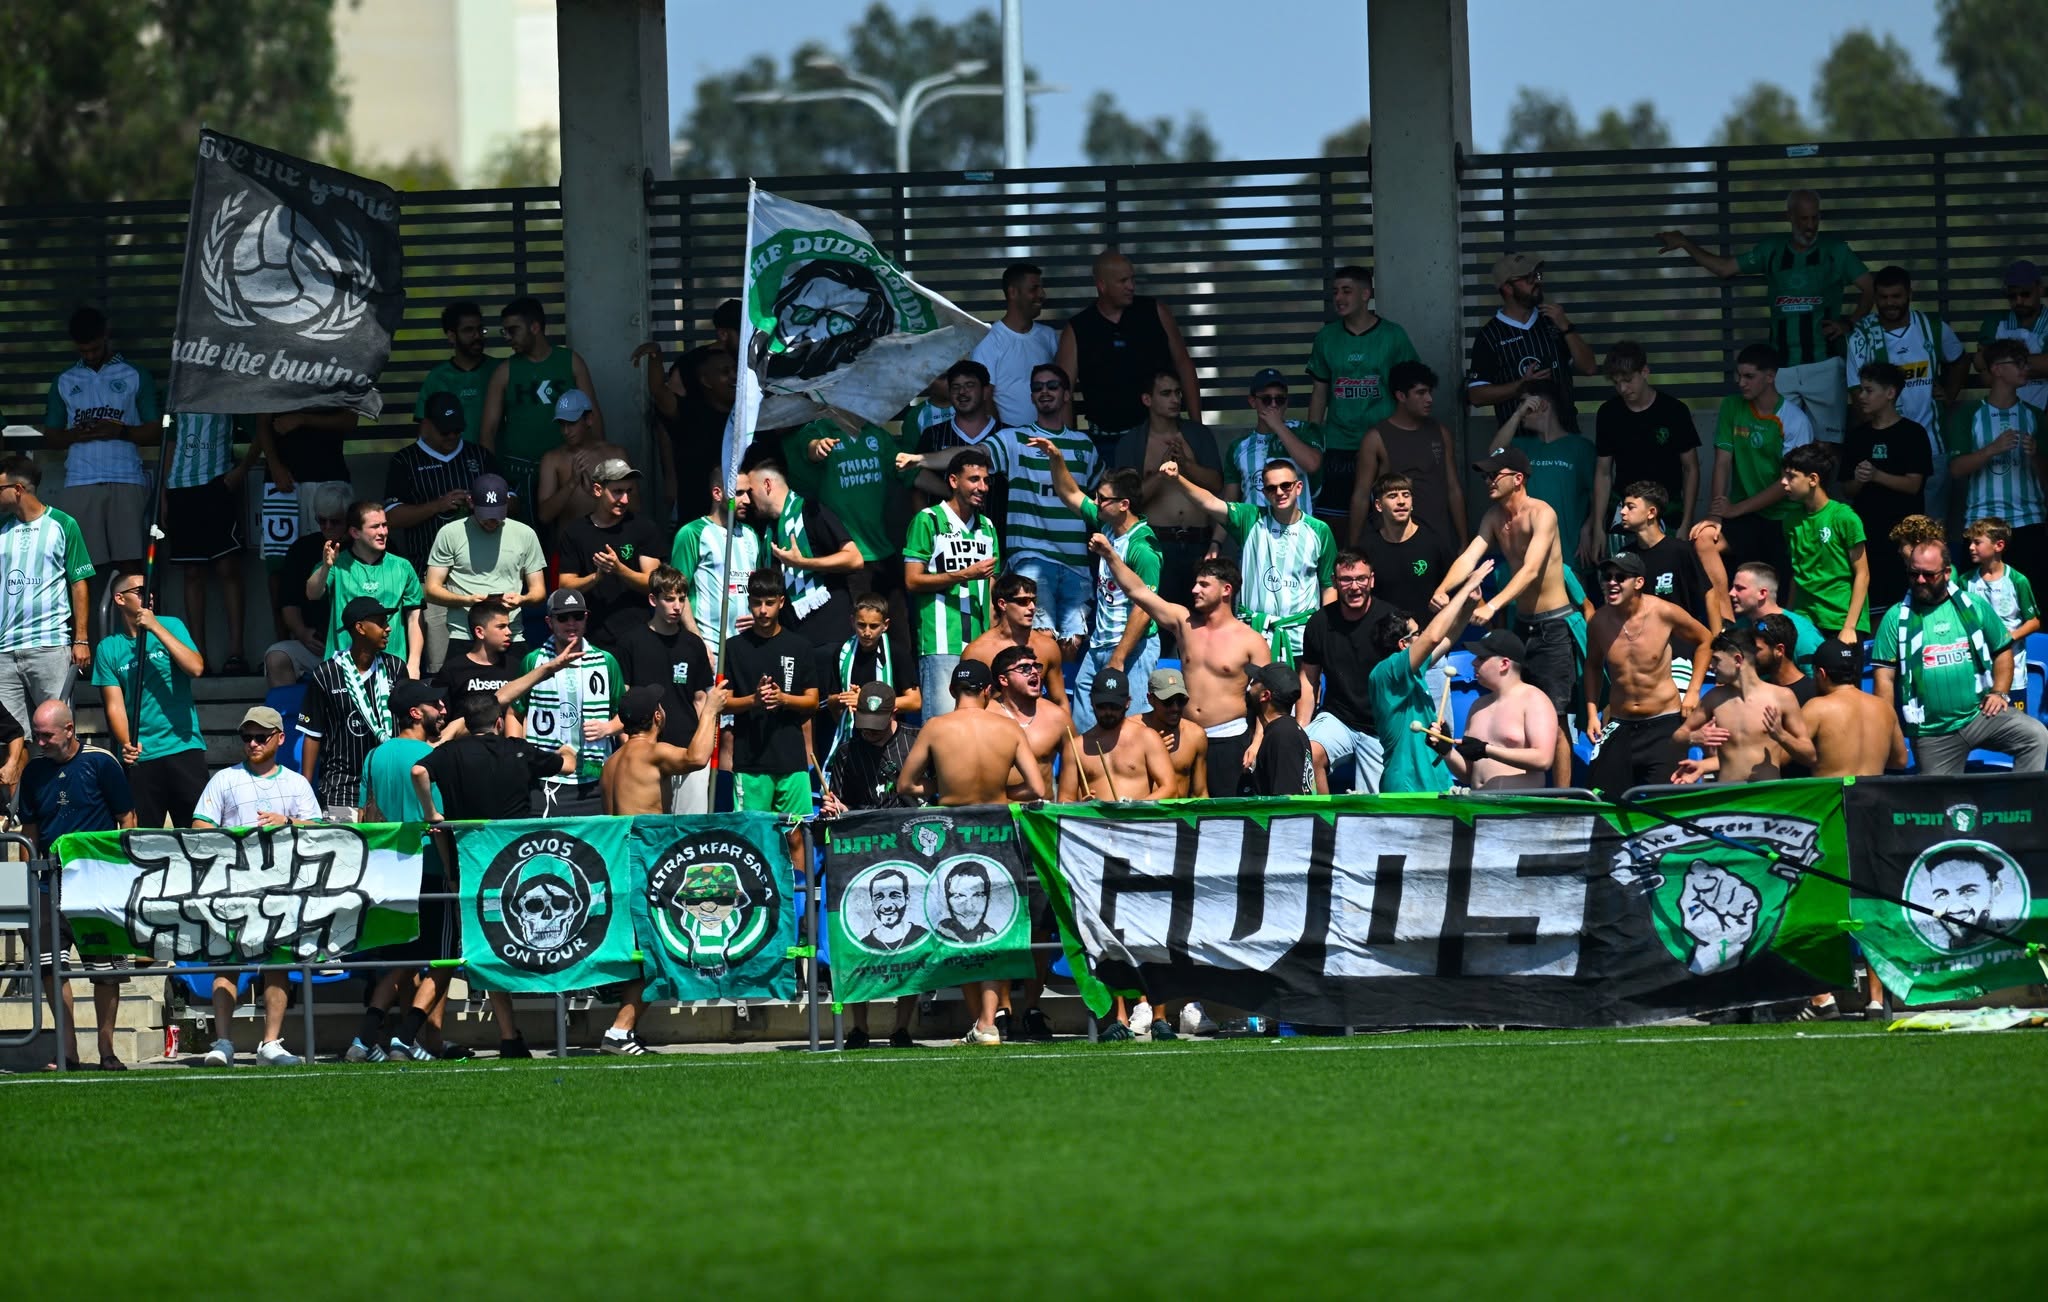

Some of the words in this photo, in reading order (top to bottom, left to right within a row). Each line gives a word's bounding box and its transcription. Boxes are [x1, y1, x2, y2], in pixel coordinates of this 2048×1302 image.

[792, 236, 872, 263] DUDE
[221, 341, 265, 376] the
[74, 404, 124, 424] Energizer
[486, 490, 498, 504] NY
[950, 541, 986, 556] שיכון
[956, 825, 1014, 844] תמיד
[1763, 821, 1803, 838] Vein
[833, 833, 898, 854] איתנו
[650, 846, 696, 902] ULTRAS
[700, 842, 743, 858] KFAR
[503, 943, 530, 963] ON
[537, 937, 588, 965] TOUR
